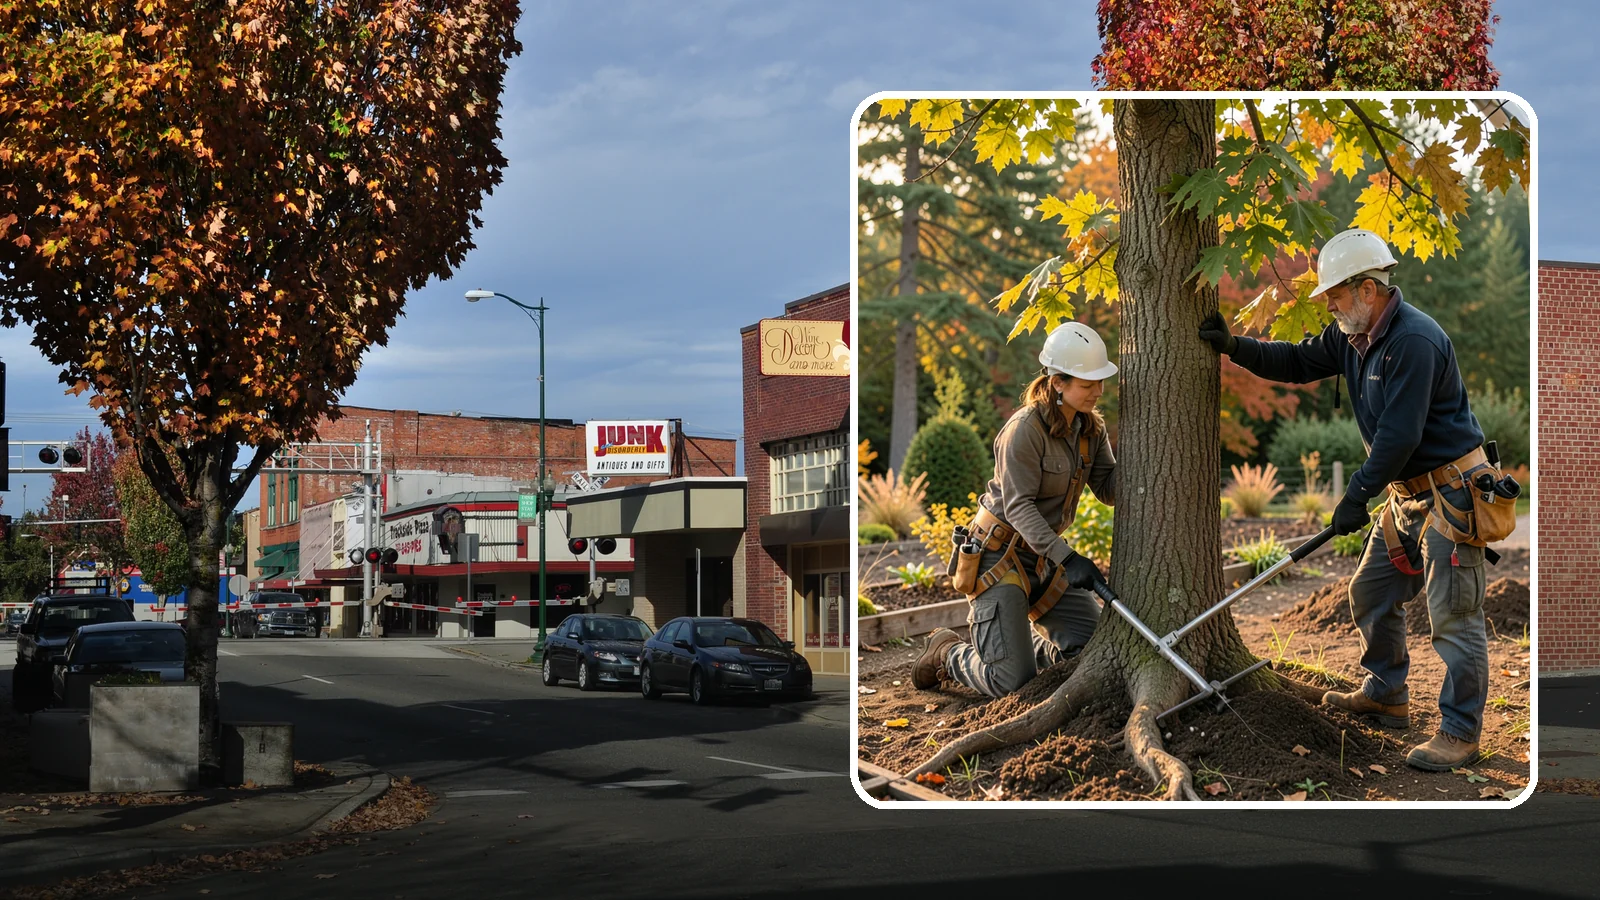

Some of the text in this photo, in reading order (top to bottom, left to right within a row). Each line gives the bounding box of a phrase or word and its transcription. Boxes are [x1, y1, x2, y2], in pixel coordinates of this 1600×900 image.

[765, 327, 831, 365] Decor
[595, 425, 665, 457] JUNK
[607, 446, 646, 454] DISORDERLY
[597, 460, 665, 470] ANTIQUES AND GIFTS
[390, 519, 429, 539] Trackside Pizza
